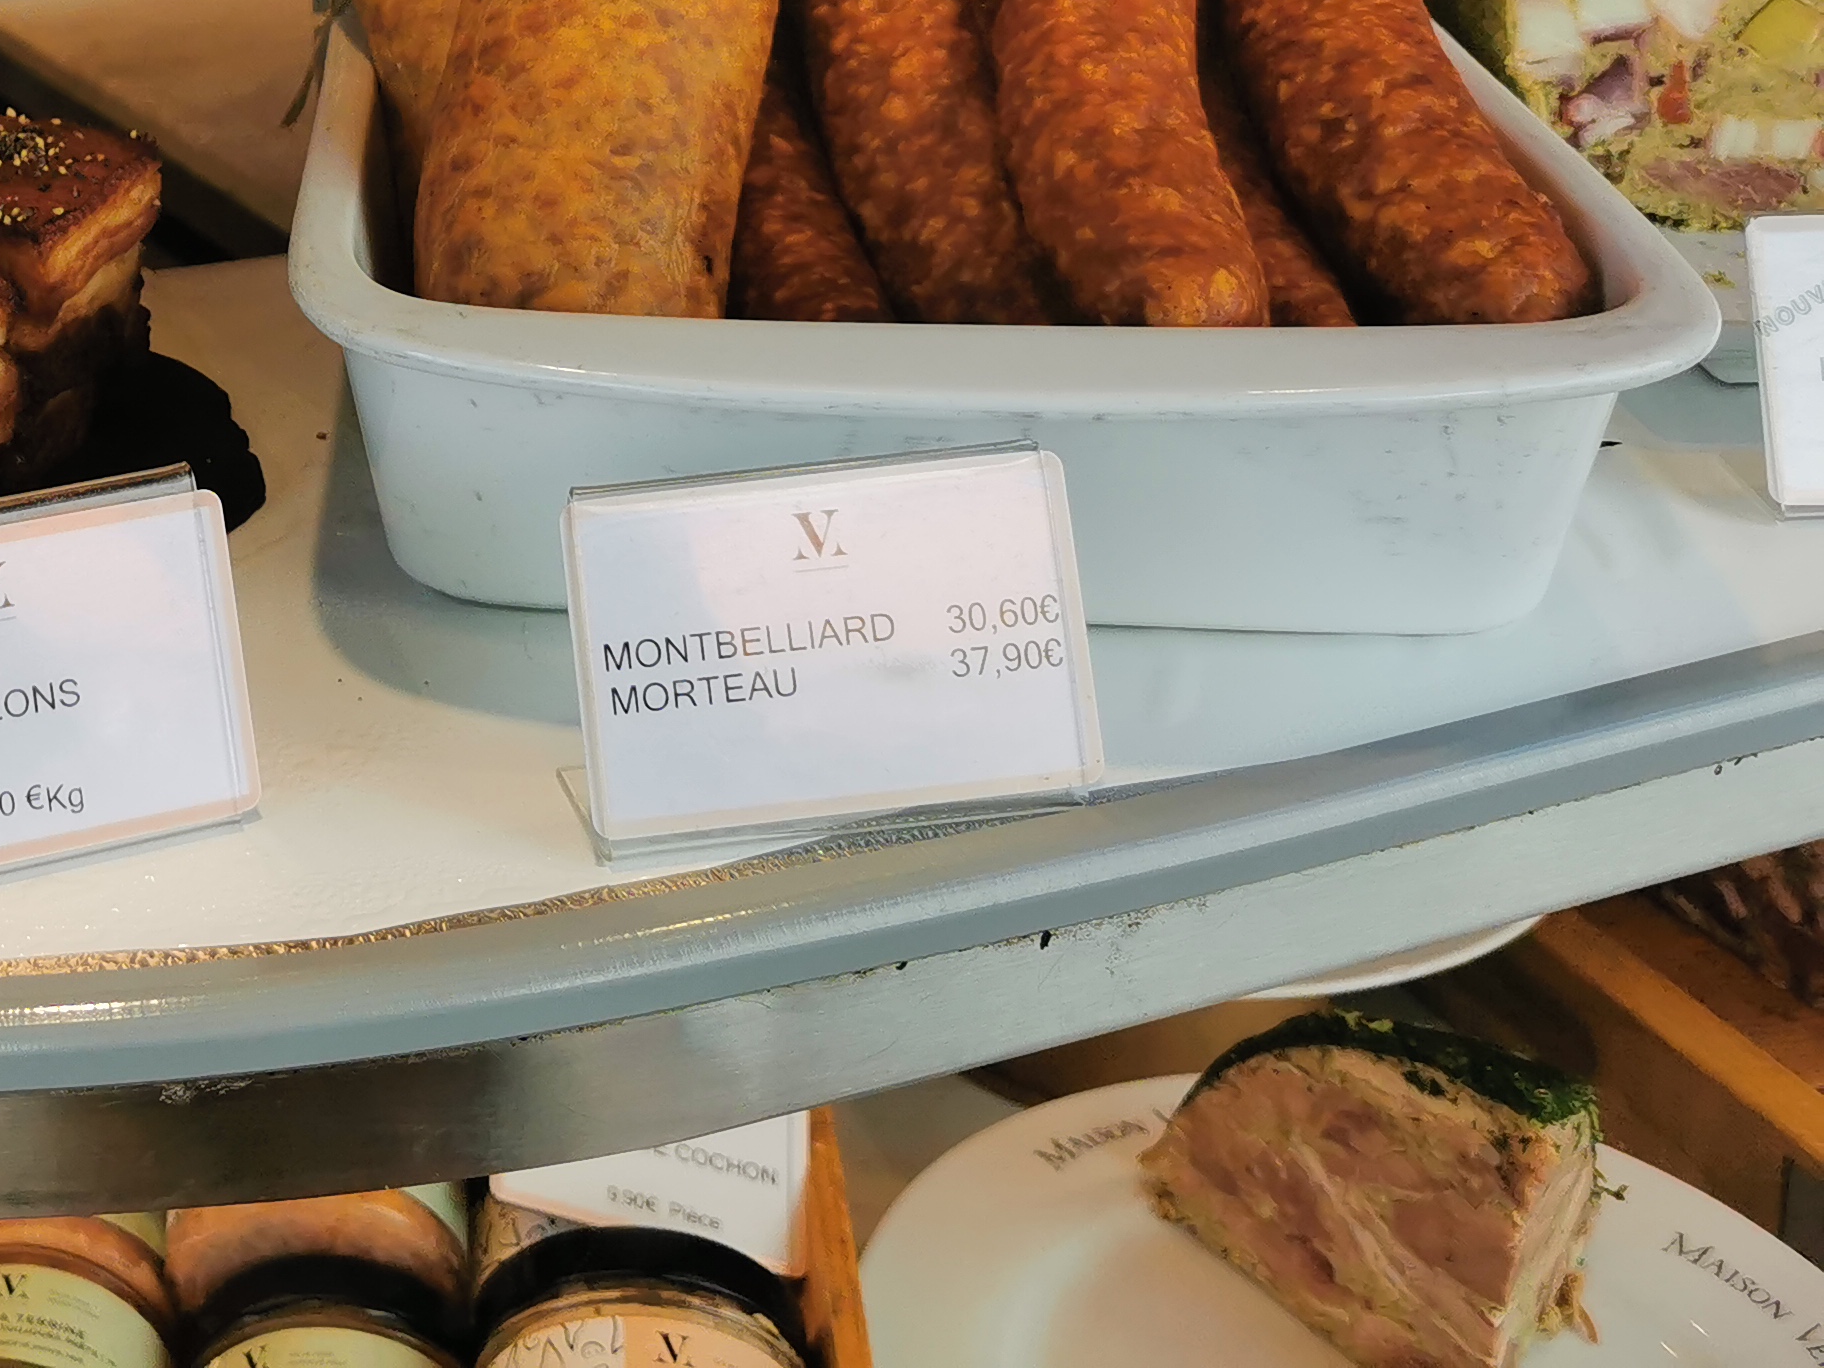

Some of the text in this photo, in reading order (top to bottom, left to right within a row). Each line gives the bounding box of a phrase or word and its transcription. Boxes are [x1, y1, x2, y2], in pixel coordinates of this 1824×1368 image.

[602, 594, 1060, 673] MONTBELLIARD 30,60€
[610, 637, 1065, 716] MORTEAU 37,90€
[26, 784, 85, 814] €Kg
[674, 1142, 780, 1186] COCHON
[1660, 1230, 1796, 1320] MAISON
